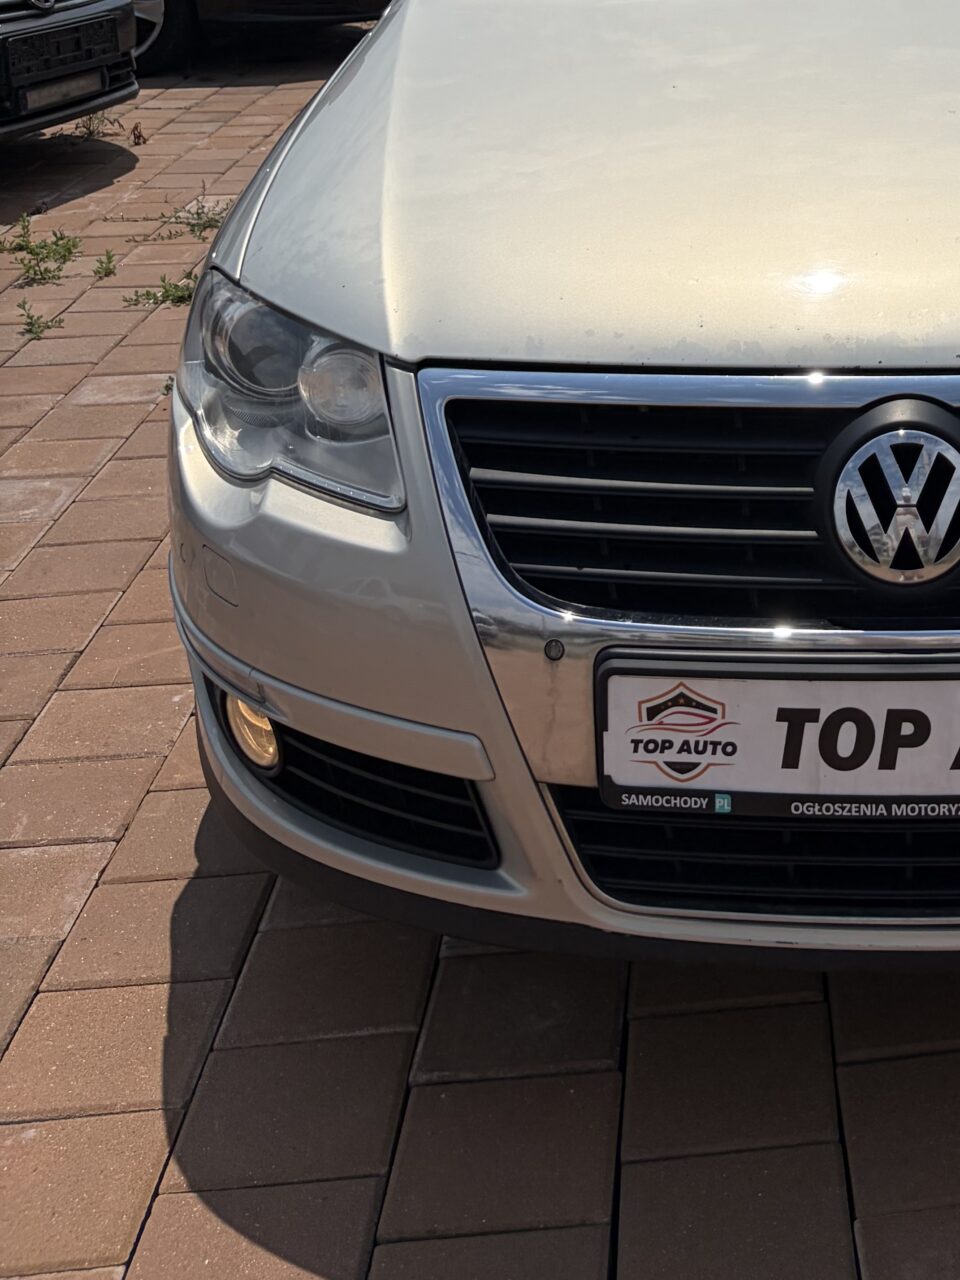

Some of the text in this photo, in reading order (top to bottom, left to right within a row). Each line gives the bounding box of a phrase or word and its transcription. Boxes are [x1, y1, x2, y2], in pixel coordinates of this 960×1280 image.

[630, 738, 738, 757] TOP AUTO
[774, 706, 932, 772] TOP
[621, 793, 732, 810] SAMOCHODY PL
[790, 801, 888, 817] OGŁOSZENIA
